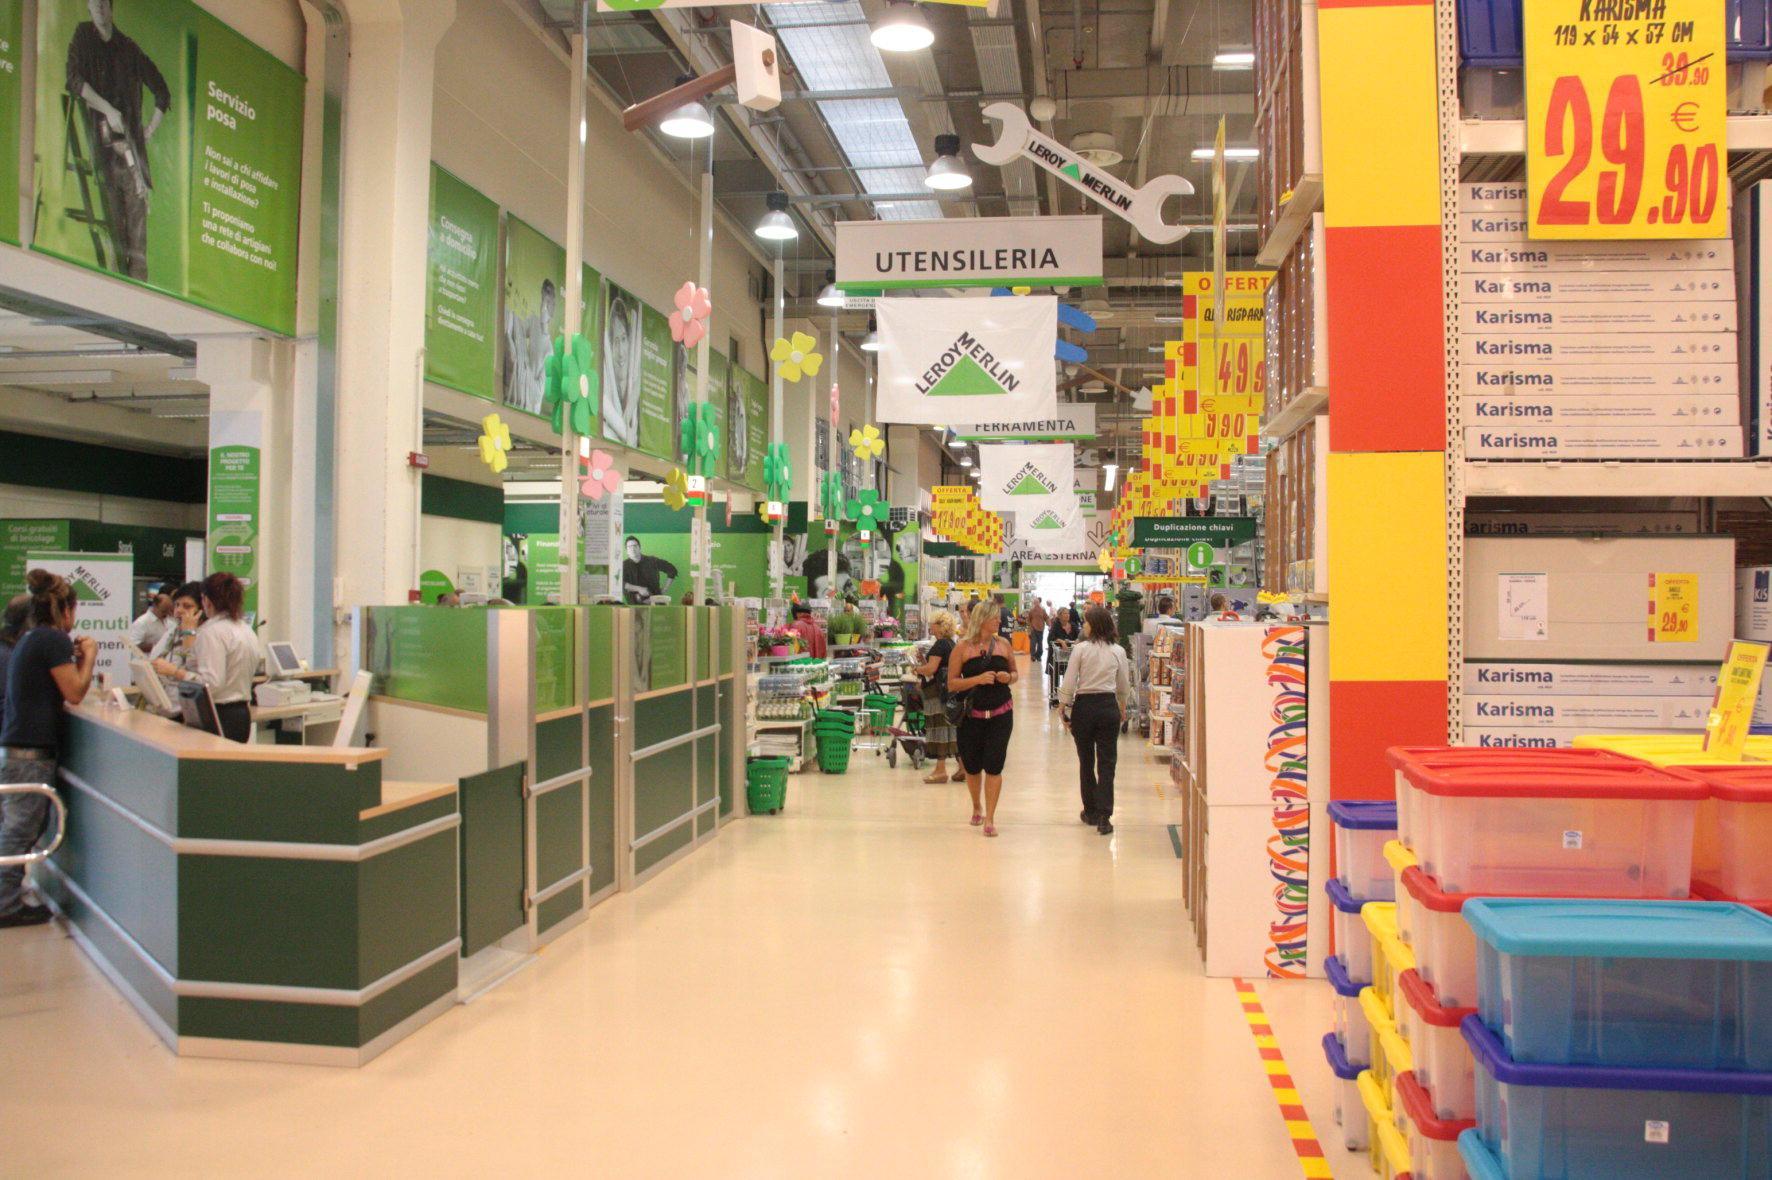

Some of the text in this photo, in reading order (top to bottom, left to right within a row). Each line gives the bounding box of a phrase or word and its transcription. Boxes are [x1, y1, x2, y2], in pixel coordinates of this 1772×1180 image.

[1580, 0, 1666, 22] KARISMA
[1554, 22, 1694, 46] 119 x 54 x 57 CM
[208, 80, 256, 120] Servizio
[206, 103, 236, 130] posa
[1670, 101, 1700, 133] €
[1028, 140, 1067, 168] LEROY
[1536, 74, 1720, 226] 29.90
[205, 145, 222, 162] Non
[240, 162, 251, 177] chi
[1081, 172, 1132, 211] MERLIN
[876, 248, 1060, 273] UTENSILERIA
[1471, 249, 1548, 264] Karisma
[1476, 310, 1552, 324] Karisma
[1476, 340, 1552, 356] Karisma
[915, 344, 962, 396] LEROY
[956, 331, 1020, 394] MERLIN
[1476, 371, 1553, 386] Karisma
[1476, 402, 1553, 417] Karisma
[975, 420, 1076, 432] FERRAMENTA
[1480, 433, 1558, 448] Karisma
[1002, 468, 1028, 495] LEROY
[1024, 461, 1058, 494] MERLIN
[1029, 510, 1048, 528] LEROY
[1046, 509, 1066, 528] MERLIN
[1154, 524, 1206, 532] Duplicazione
[1011, 550, 1042, 560] AREA
[74, 566, 110, 600] MERLIN
[73, 616, 128, 630] venuti
[1478, 668, 1553, 683] Karisma
[1476, 702, 1554, 716] Karisma
[1480, 734, 1556, 748] Karisma
